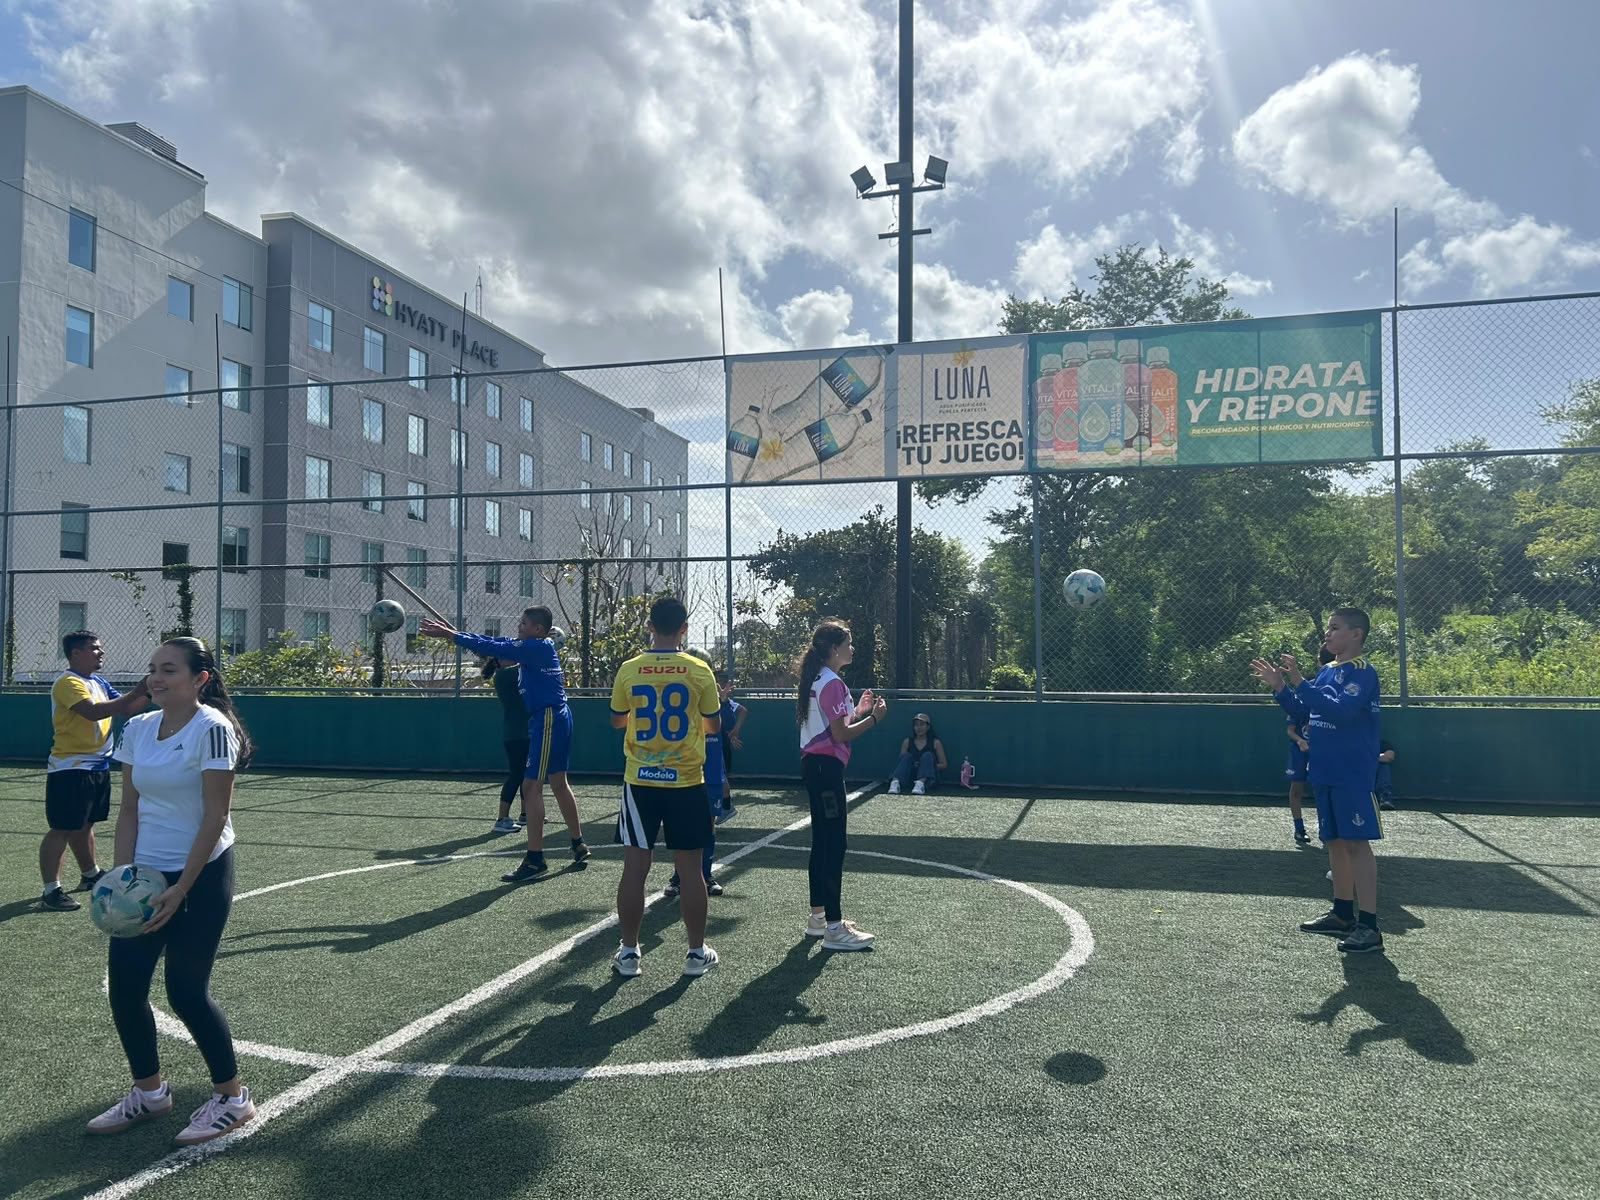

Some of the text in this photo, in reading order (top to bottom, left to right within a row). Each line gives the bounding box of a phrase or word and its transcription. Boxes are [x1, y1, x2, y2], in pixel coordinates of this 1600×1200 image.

[395, 301, 499, 368] HYATT PLACE
[831, 373, 855, 398] LUNA
[934, 365, 991, 401] LUNA
[1194, 361, 1367, 394] HIDRATA
[1185, 399, 1211, 423] Y
[1219, 390, 1381, 422] REPONE
[897, 419, 1023, 450] ¡REFRESCA
[1191, 426, 1250, 435] RECOMENDADO
[1269, 422, 1303, 431] MÉDICOS
[733, 439, 750, 453] LUNA
[812, 431, 828, 452] LUNA
[902, 441, 1024, 466] TU JUEGO!
[638, 666, 687, 674] ISUZU
[631, 683, 690, 742] 38
[640, 769, 675, 780] Modelo
